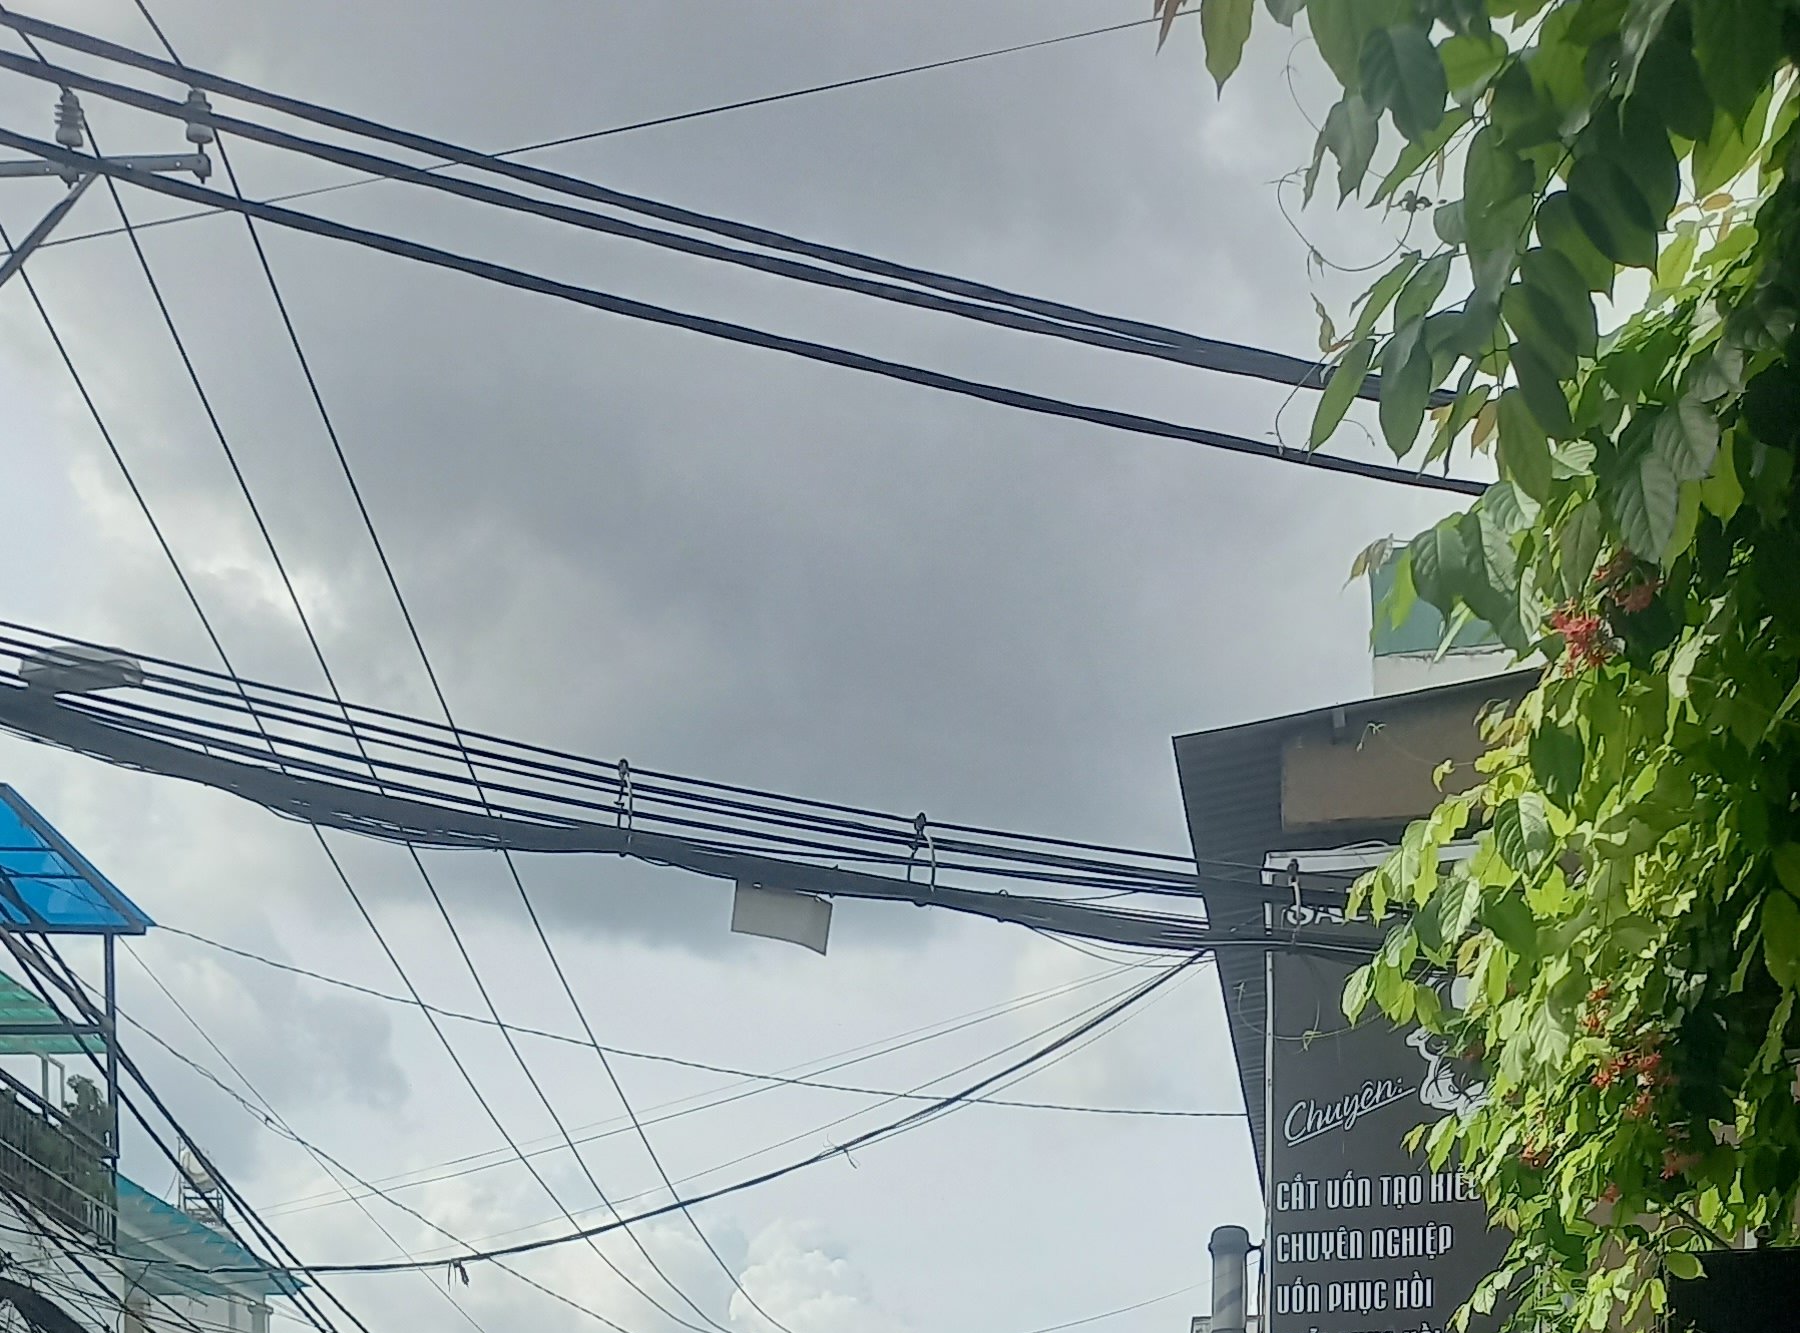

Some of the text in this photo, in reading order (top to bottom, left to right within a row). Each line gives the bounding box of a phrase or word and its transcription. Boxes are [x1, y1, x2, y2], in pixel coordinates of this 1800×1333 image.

[1284, 1077, 1403, 1143] Chuyên:
[1276, 1173, 1319, 1211] CẮT
[1327, 1170, 1371, 1209] UỐN
[1380, 1175, 1422, 1209] TẠO
[1276, 1221, 1453, 1263] CHUYÊN NGHIỆP
[1276, 1270, 1433, 1315] UỐN PHỤC HỒI
